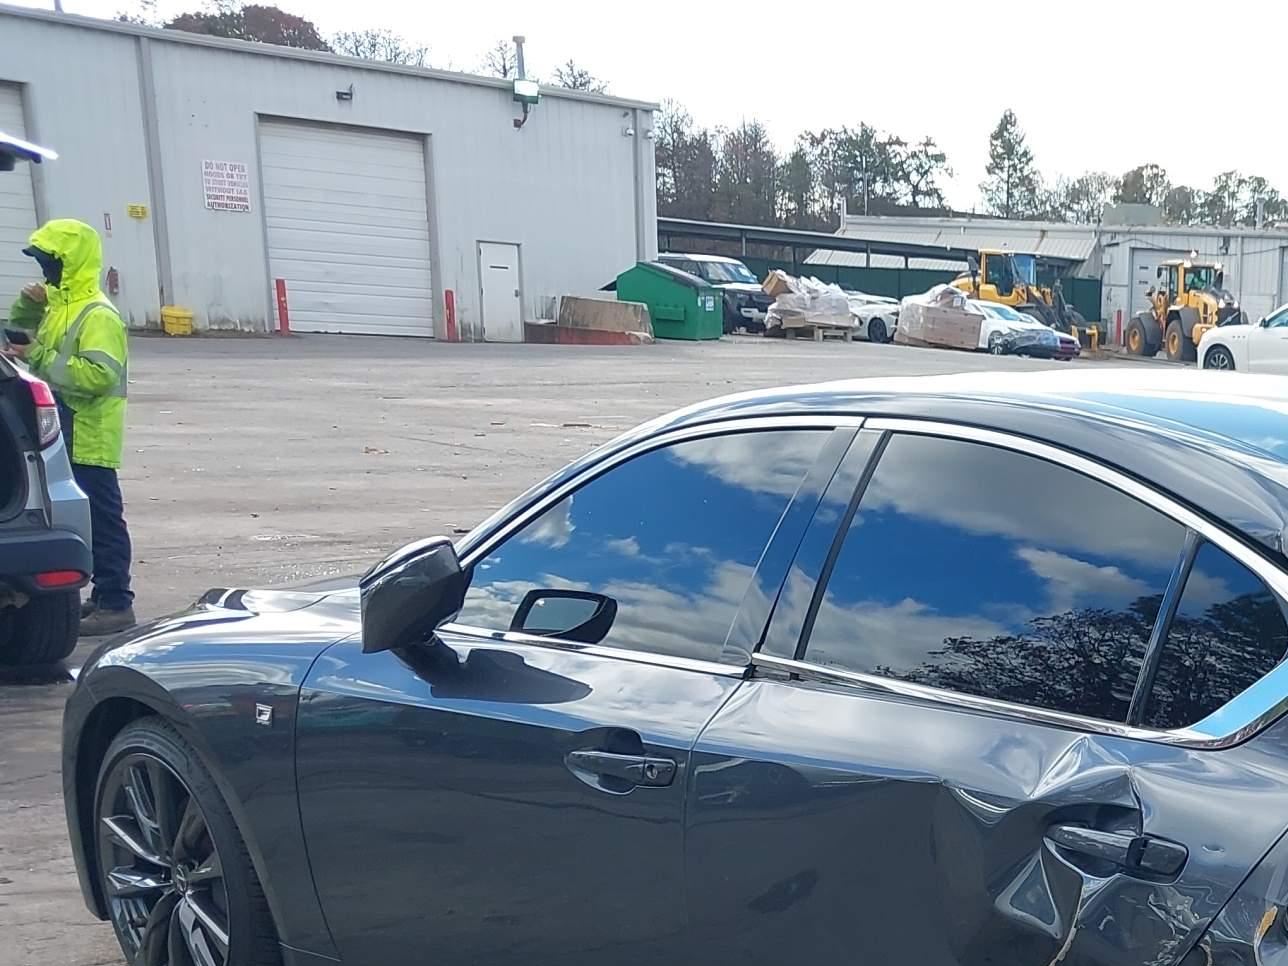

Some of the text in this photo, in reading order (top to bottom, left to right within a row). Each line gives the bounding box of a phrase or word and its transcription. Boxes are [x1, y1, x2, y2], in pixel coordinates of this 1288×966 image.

[205, 161, 245, 173] DO NOT OPEN
[236, 173, 247, 181] TRY
[206, 186, 234, 194] WITHOUT
[206, 194, 248, 203] SECURITY PERSONNEL
[207, 201, 249, 210] AUTHORIZATION
